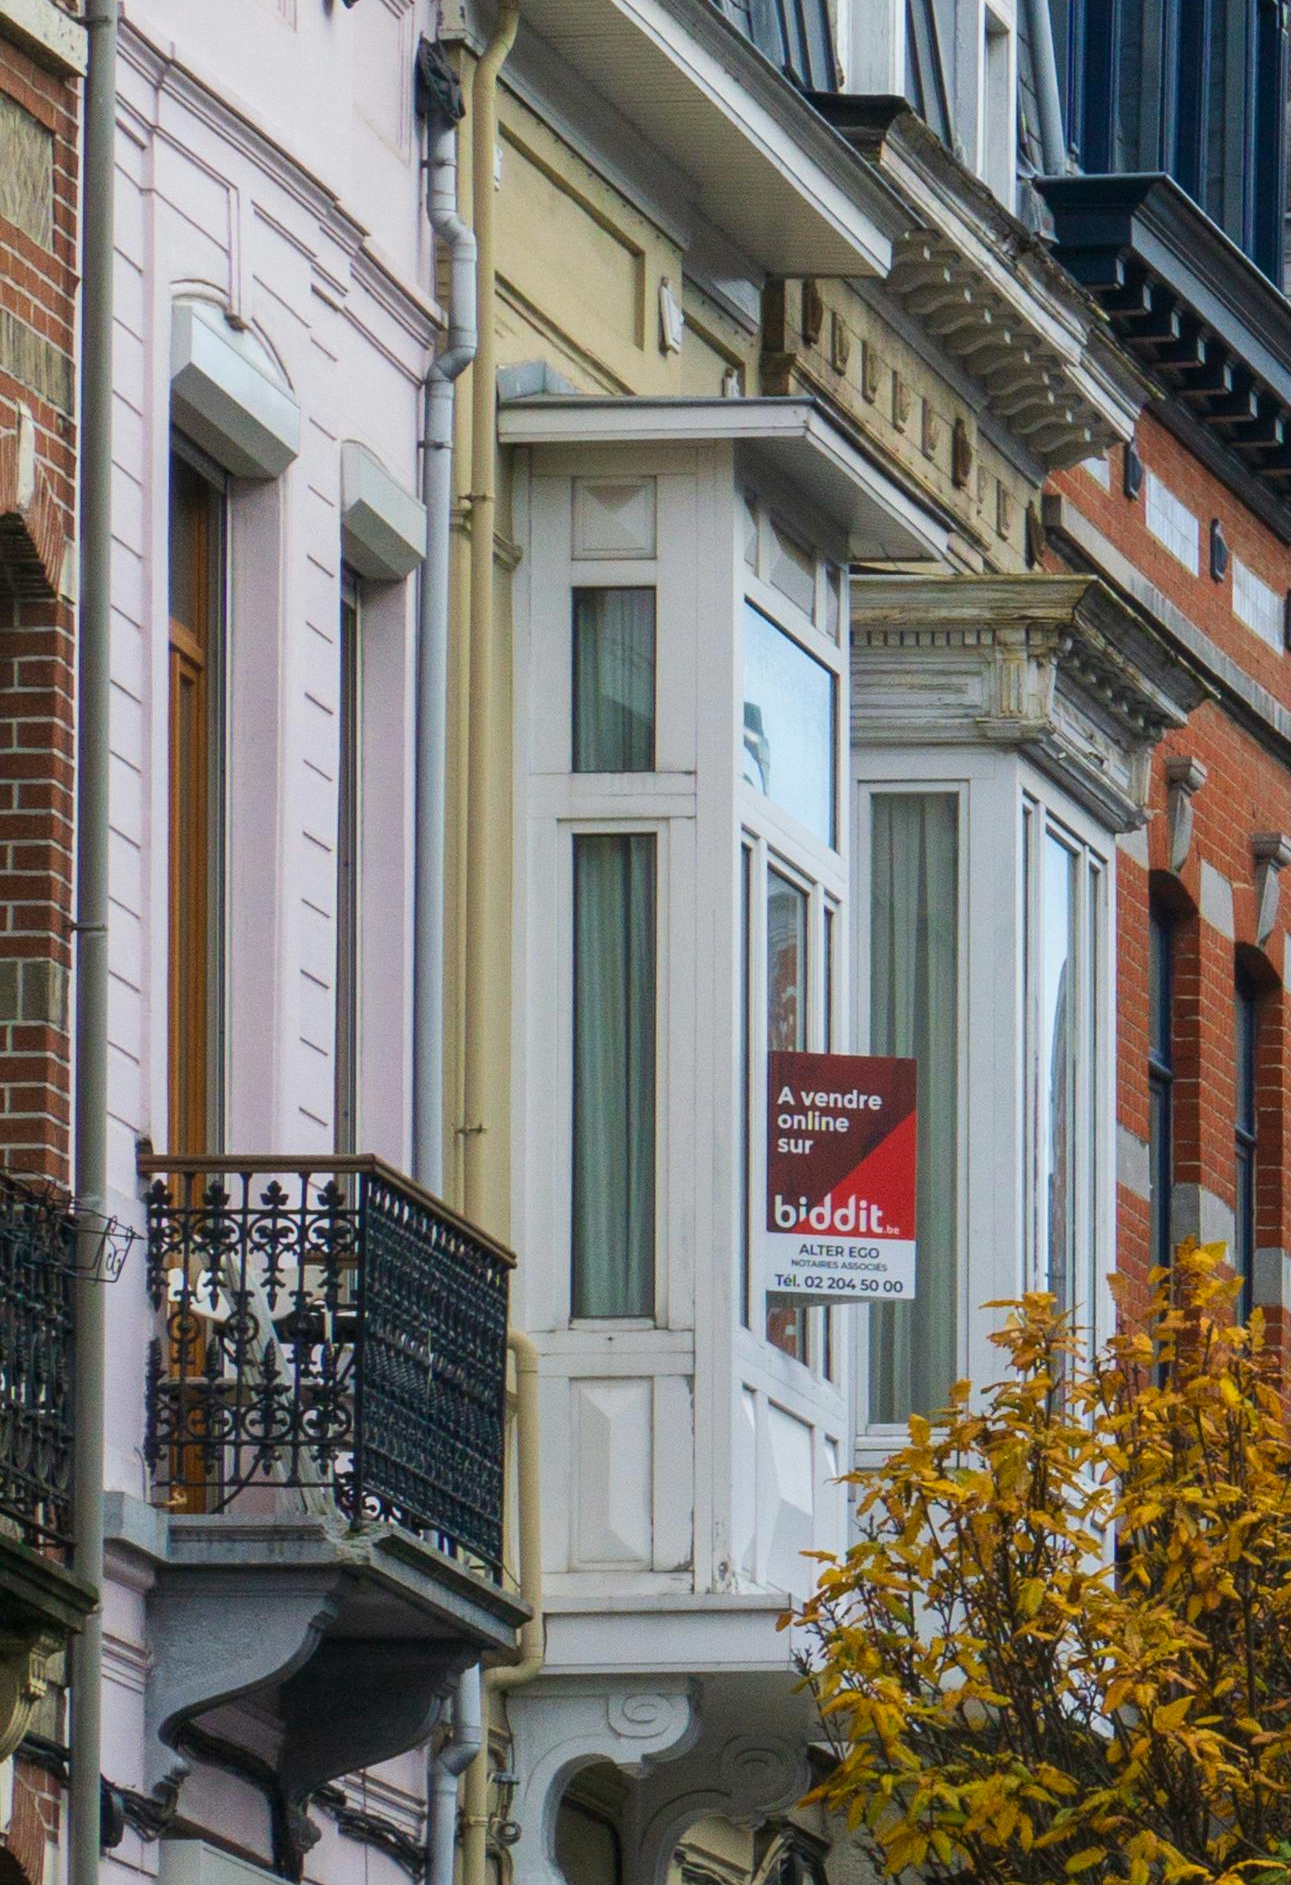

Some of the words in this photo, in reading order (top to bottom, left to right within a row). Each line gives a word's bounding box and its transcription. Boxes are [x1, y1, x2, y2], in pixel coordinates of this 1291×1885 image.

[777, 1086, 795, 1105] A
[801, 1089, 882, 1111] vendre
[777, 1111, 849, 1133] online
[777, 1138, 814, 1155] sur
[774, 1192, 900, 1235] biddit.be
[799, 1243, 845, 1258] ALTER
[848, 1246, 880, 1259] EGO
[791, 1258, 839, 1270] NOTAIRES
[840, 1260, 888, 1273] ASSOCIÉS
[774, 1273, 800, 1288] Tél.
[804, 1275, 823, 1289] 02
[827, 1276, 857, 1291] 204
[860, 1278, 879, 1292] 50
[883, 1280, 903, 1293] 00
